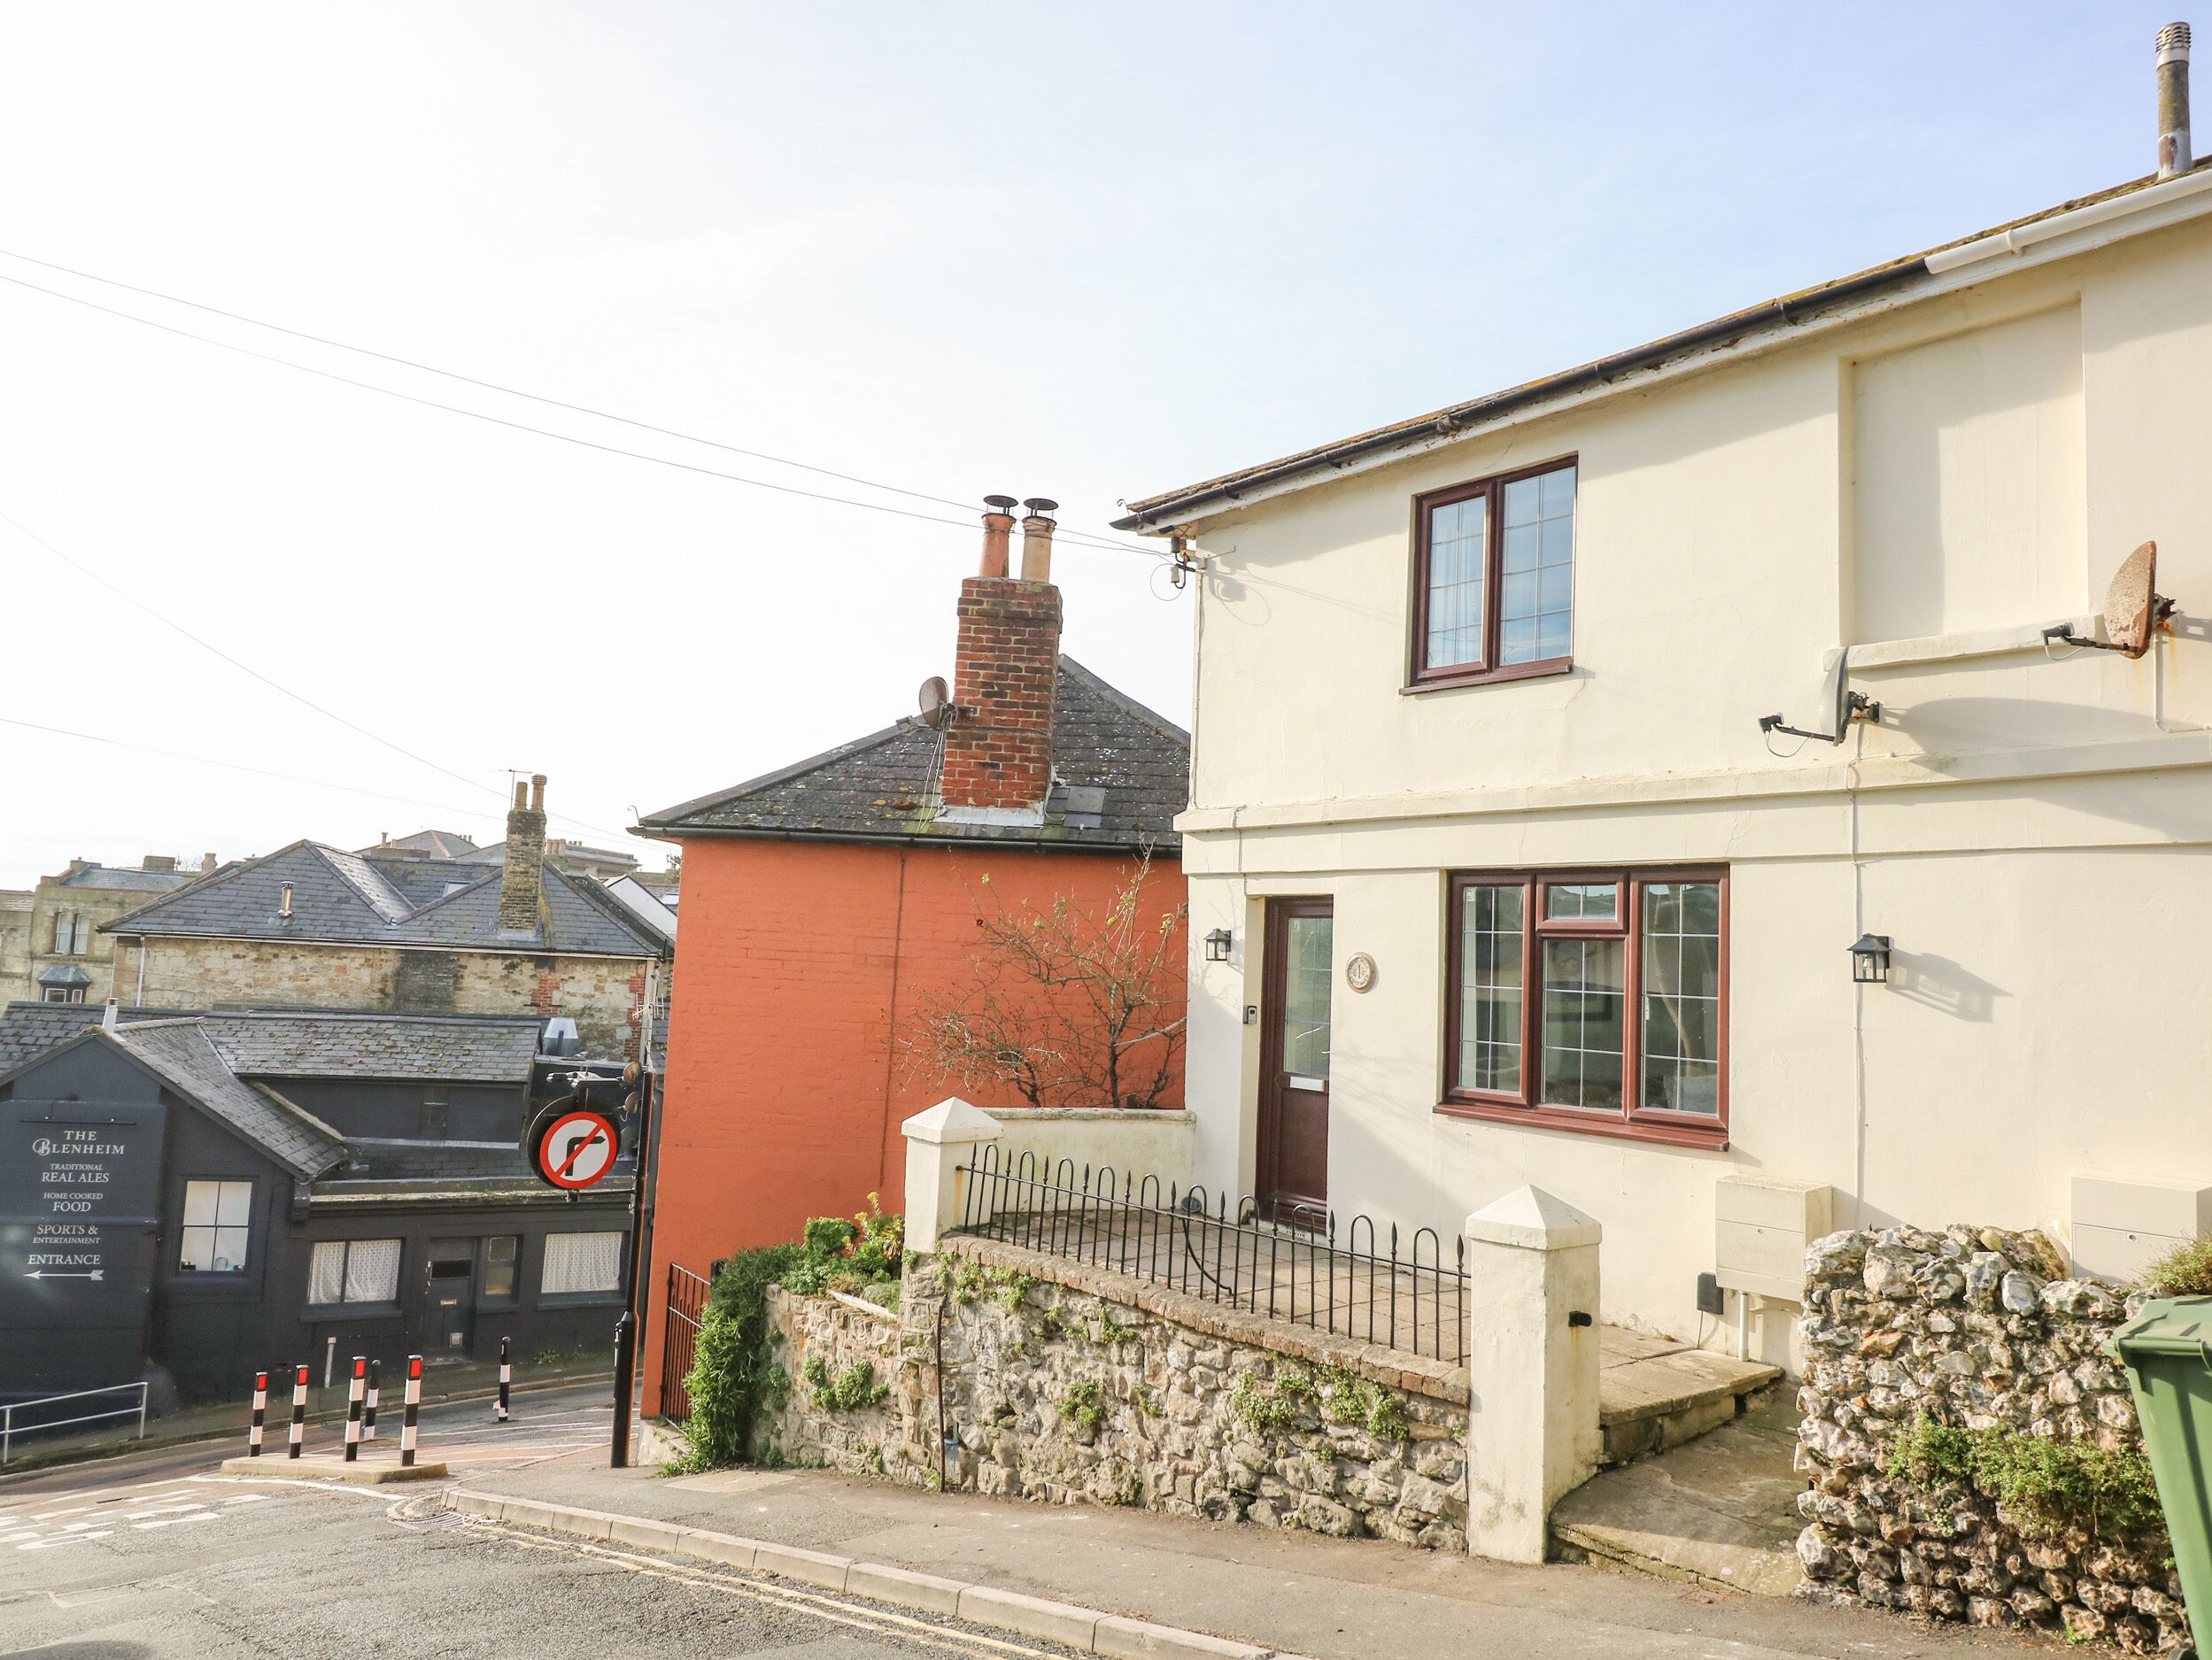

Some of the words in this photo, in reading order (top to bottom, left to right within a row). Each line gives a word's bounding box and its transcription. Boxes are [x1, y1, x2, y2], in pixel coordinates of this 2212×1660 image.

[64, 1131, 97, 1140] THE
[32, 1138, 125, 1156] BLENHEIM
[41, 1172, 75, 1183] REAL
[77, 1172, 110, 1183] ALES
[52, 1201, 91, 1212] FOOD
[36, 1224, 86, 1235] SPORTS
[88, 1225, 99, 1235] &
[27, 1254, 101, 1265] ENTRANCE
